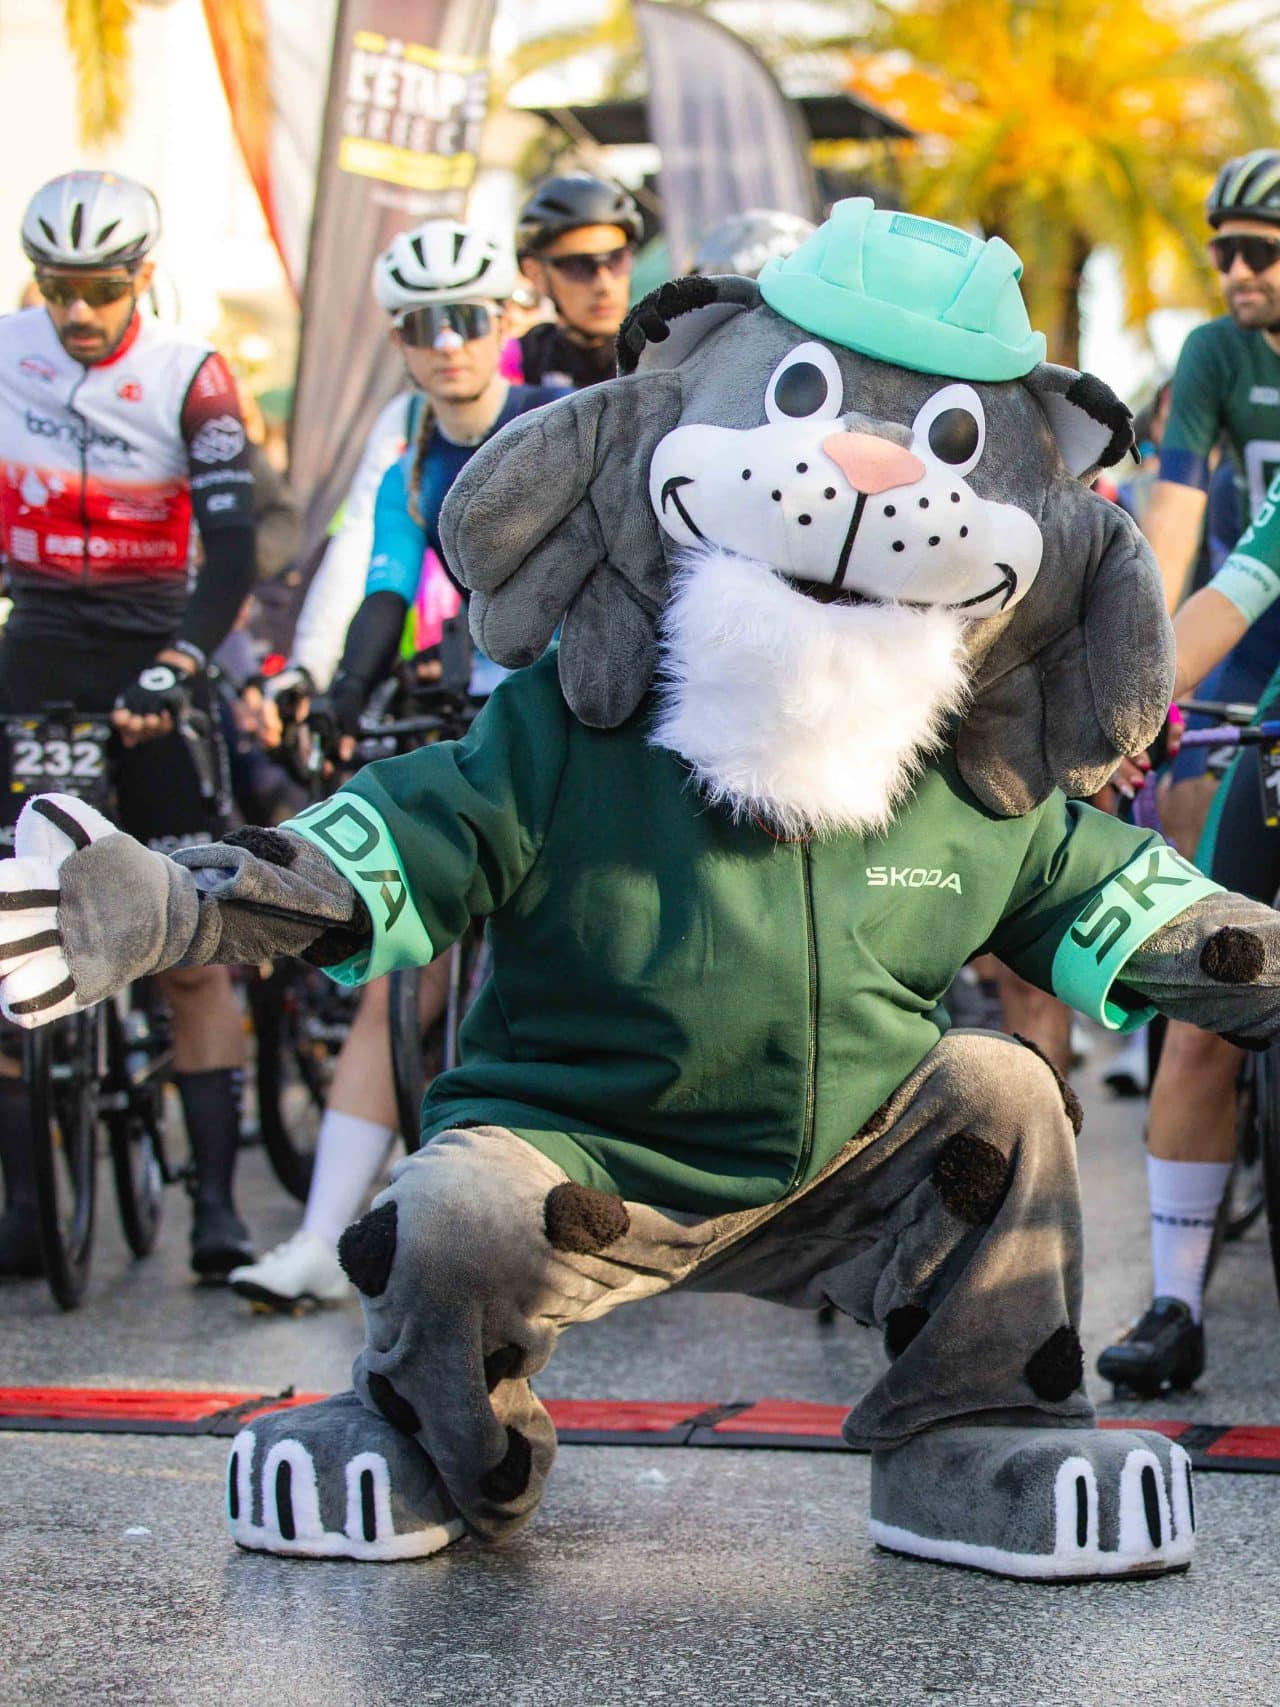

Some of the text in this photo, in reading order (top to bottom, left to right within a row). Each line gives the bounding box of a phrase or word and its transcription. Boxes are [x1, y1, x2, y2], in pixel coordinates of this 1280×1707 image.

[13, 740, 103, 776] 232
[293, 798, 408, 934] DA
[865, 866, 962, 895] SKODA
[1068, 848, 1206, 967] SK
